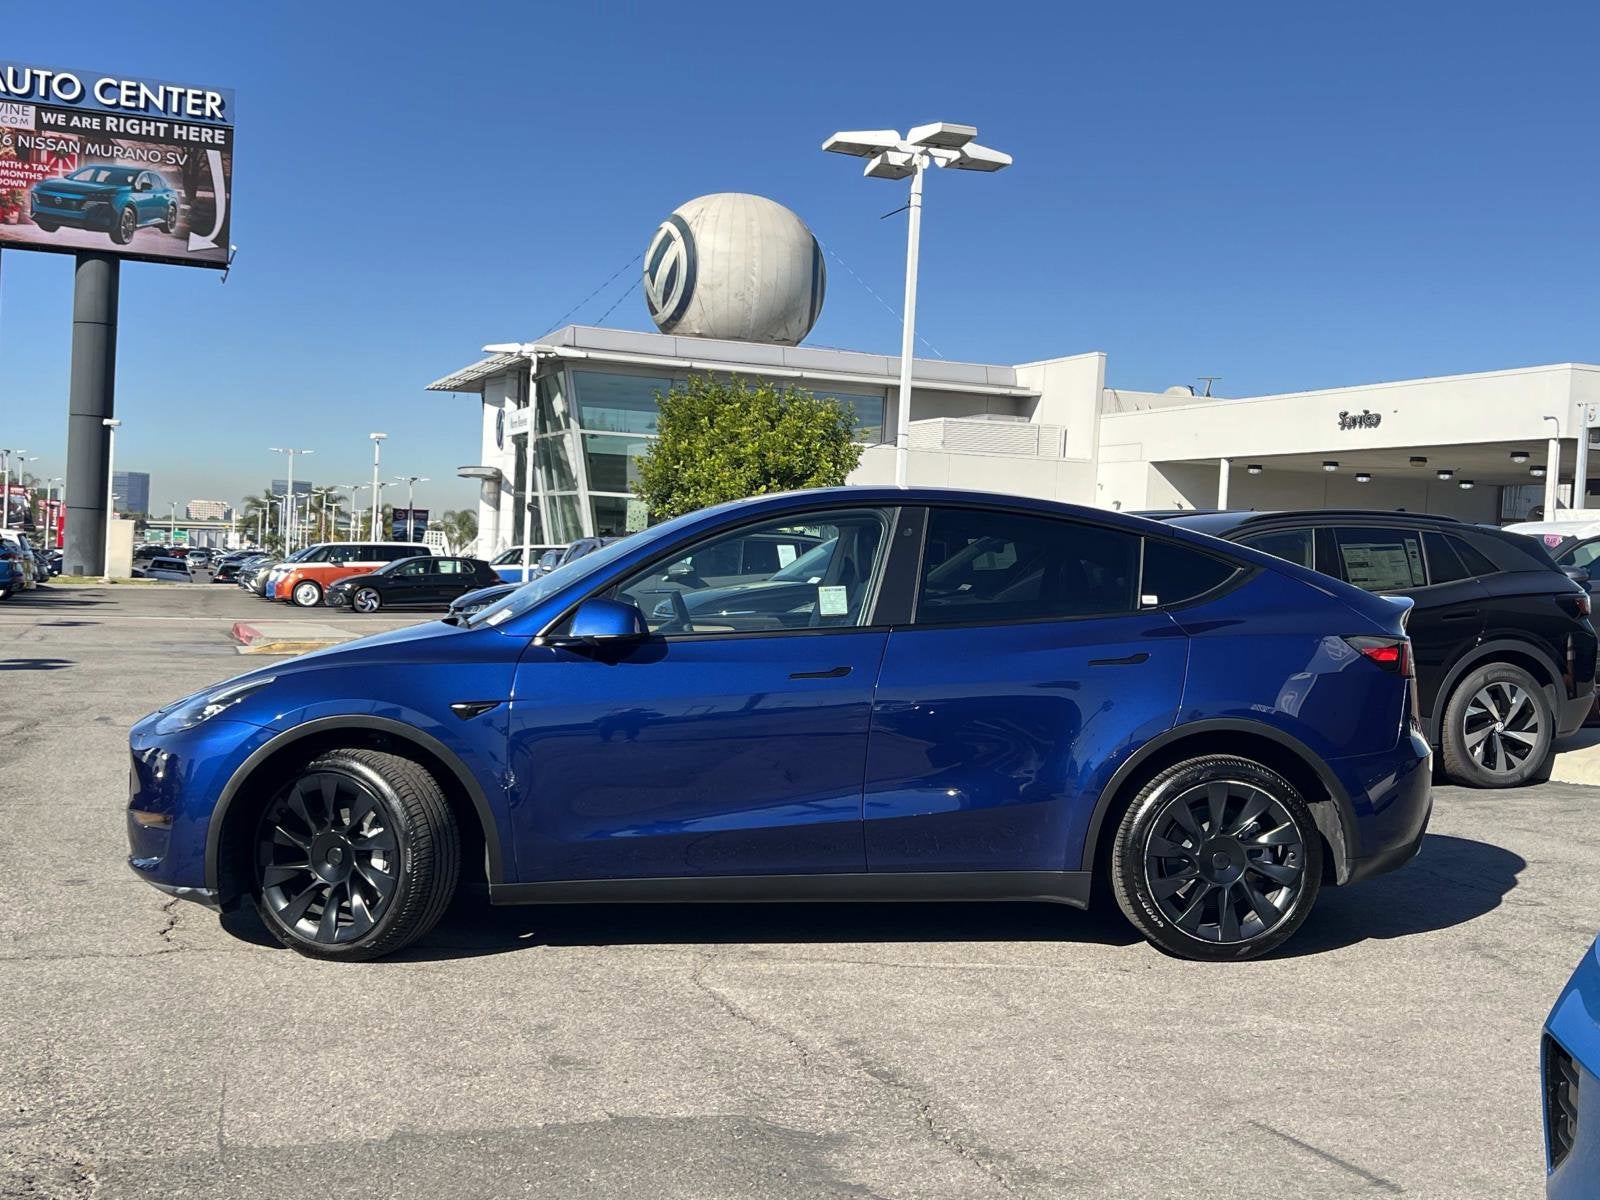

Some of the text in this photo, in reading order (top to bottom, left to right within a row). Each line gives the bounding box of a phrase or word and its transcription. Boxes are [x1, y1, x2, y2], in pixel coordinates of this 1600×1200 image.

[93, 77, 223, 119] CENTER
[41, 112, 226, 145] WE ARE RIGHT HERE
[17, 134, 81, 154] NISSAN
[85, 143, 162, 164] MURANO
[166, 152, 188, 166] SV
[0, 169, 43, 180] MONTHS
[31, 163, 51, 173] TAX
